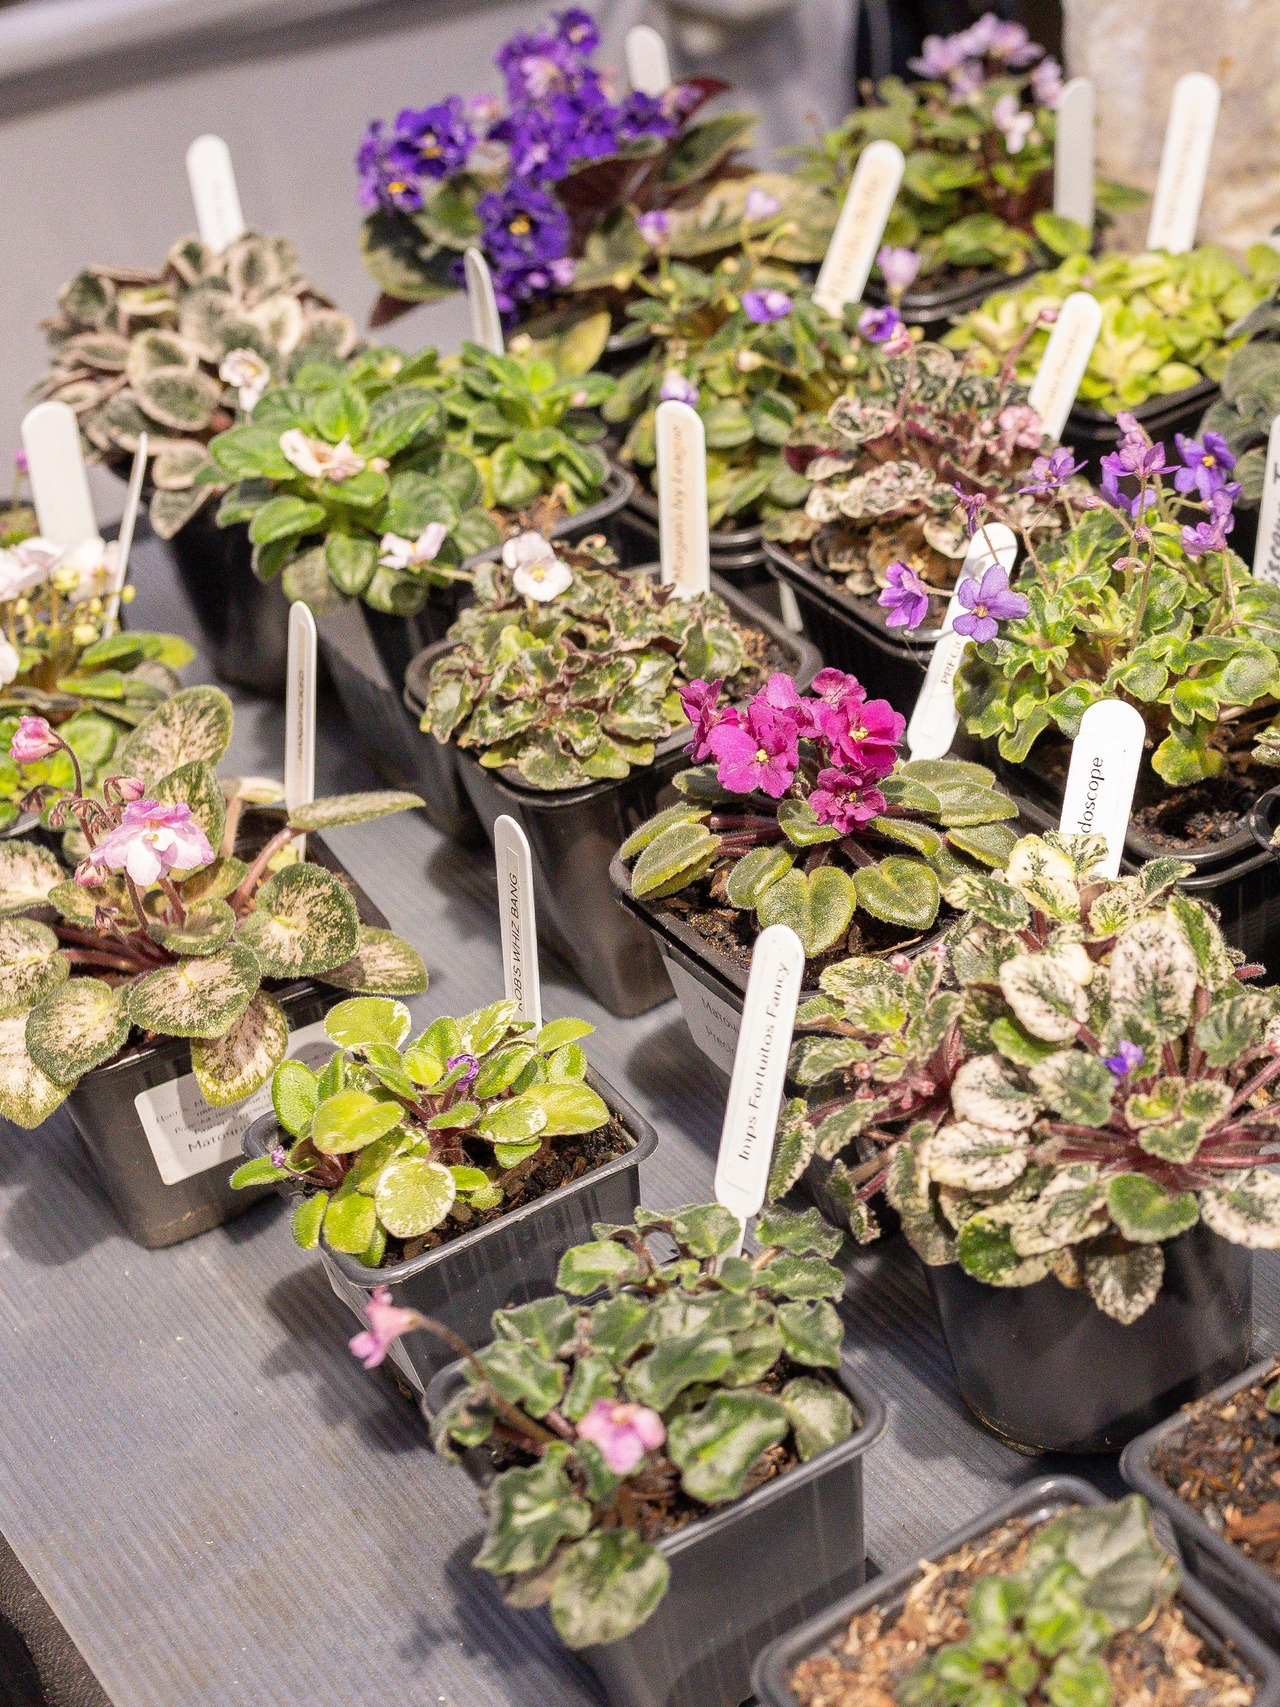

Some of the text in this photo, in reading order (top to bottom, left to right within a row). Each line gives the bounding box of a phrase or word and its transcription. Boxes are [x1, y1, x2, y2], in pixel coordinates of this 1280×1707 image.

[509, 873, 520, 920] BANG
[511, 919, 521, 964] WHIZ
[739, 961, 789, 1161] Imps Fortuitos Fancy
